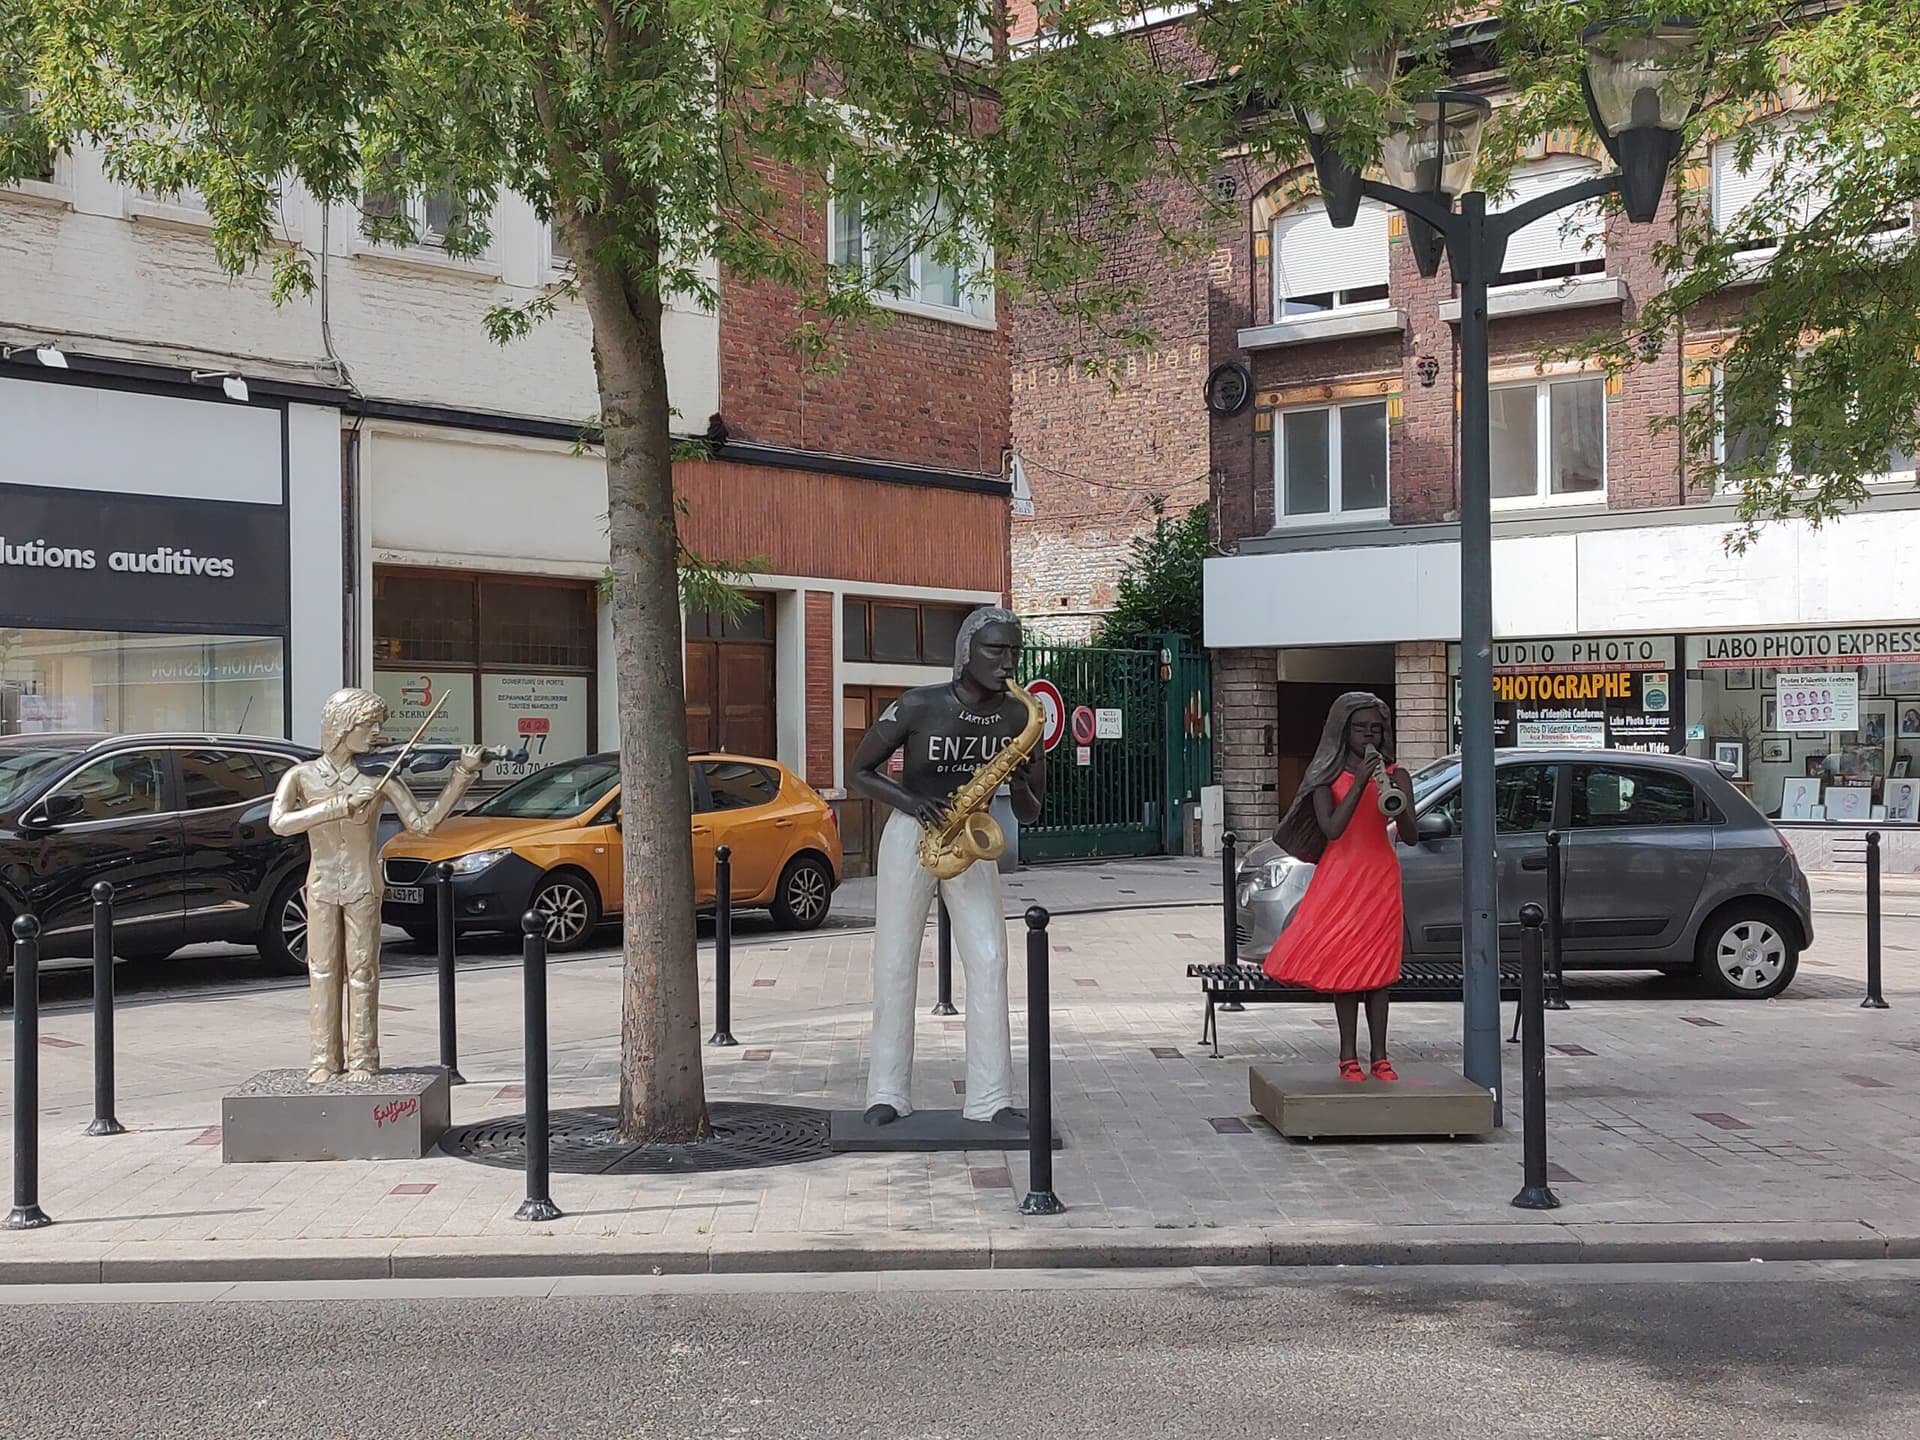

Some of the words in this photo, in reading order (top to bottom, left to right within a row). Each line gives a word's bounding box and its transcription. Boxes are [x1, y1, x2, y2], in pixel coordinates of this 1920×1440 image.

[0, 537, 96, 569] lutions
[108, 547, 235, 578] auditives
[1497, 644, 1554, 664] UDIO
[1572, 641, 1654, 662] PHOTO
[1706, 637, 1758, 659] LABO
[1763, 634, 1832, 657] PHOTO
[1837, 631, 1920, 655] EXPRESS
[1516, 708, 1539, 719] Photos
[1573, 708, 1604, 719] Conforme
[1609, 715, 1625, 726] Labo
[1626, 715, 1644, 726] Photo
[1645, 715, 1670, 727] Express
[496, 763, 509, 775] 03
[513, 763, 524, 775] 20
